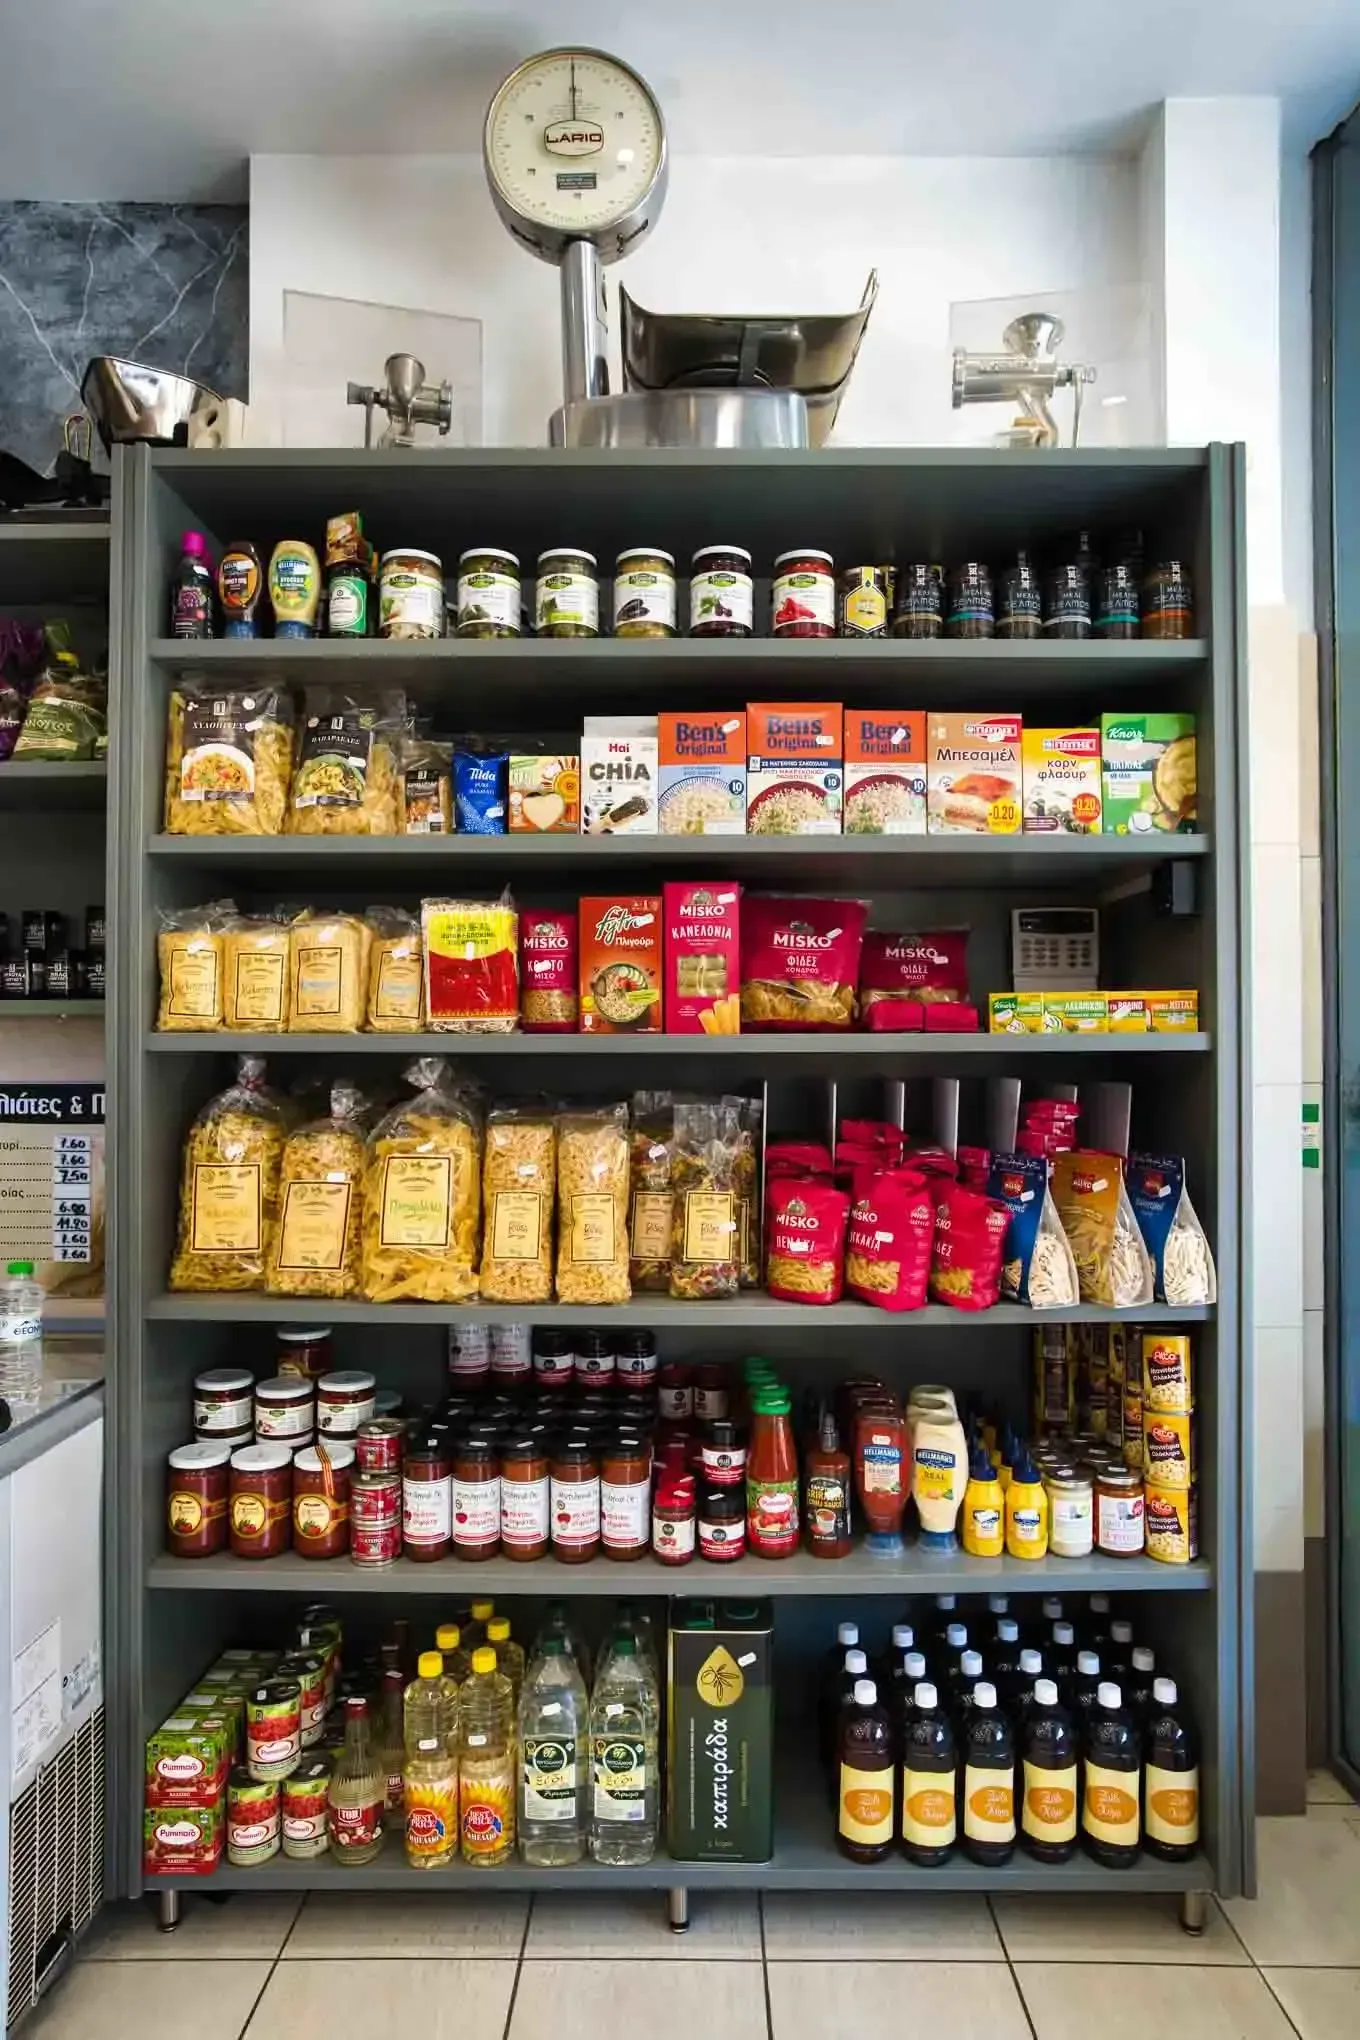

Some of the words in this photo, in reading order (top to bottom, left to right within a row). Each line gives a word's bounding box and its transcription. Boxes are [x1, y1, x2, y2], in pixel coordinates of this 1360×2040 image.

[546, 134, 601, 143] LARIO
[1107, 727, 1144, 738] Knorr
[608, 743, 631, 753] Hai
[676, 742, 727, 756] Original
[936, 748, 1017, 764] Μπεσαμέλ
[1047, 759, 1077, 770] κορν
[469, 768, 496, 781] Tilda
[827, 779, 837, 787] 10
[913, 780, 924, 791] 10
[680, 905, 725, 917] MISKO
[672, 925, 732, 941] ΚΑΝΕΛΟΝΙΑ
[523, 937, 569, 949] MISKO
[773, 933, 833, 948] MISKO
[885, 947, 938, 959] MISKO
[527, 960, 564, 973] ΚΤΟ
[787, 956, 817, 967] ΦΙΔΕΣ
[900, 964, 929, 974] ΦΙΔΕΣ
[70, 1095, 83, 1114] &
[777, 1214, 819, 1229] MISKO
[936, 1218, 952, 1230] SKO
[923, 1471, 945, 1481] REAL
[705, 1718, 735, 1829] καπιράδα
[342, 1810, 359, 1819] TOP
